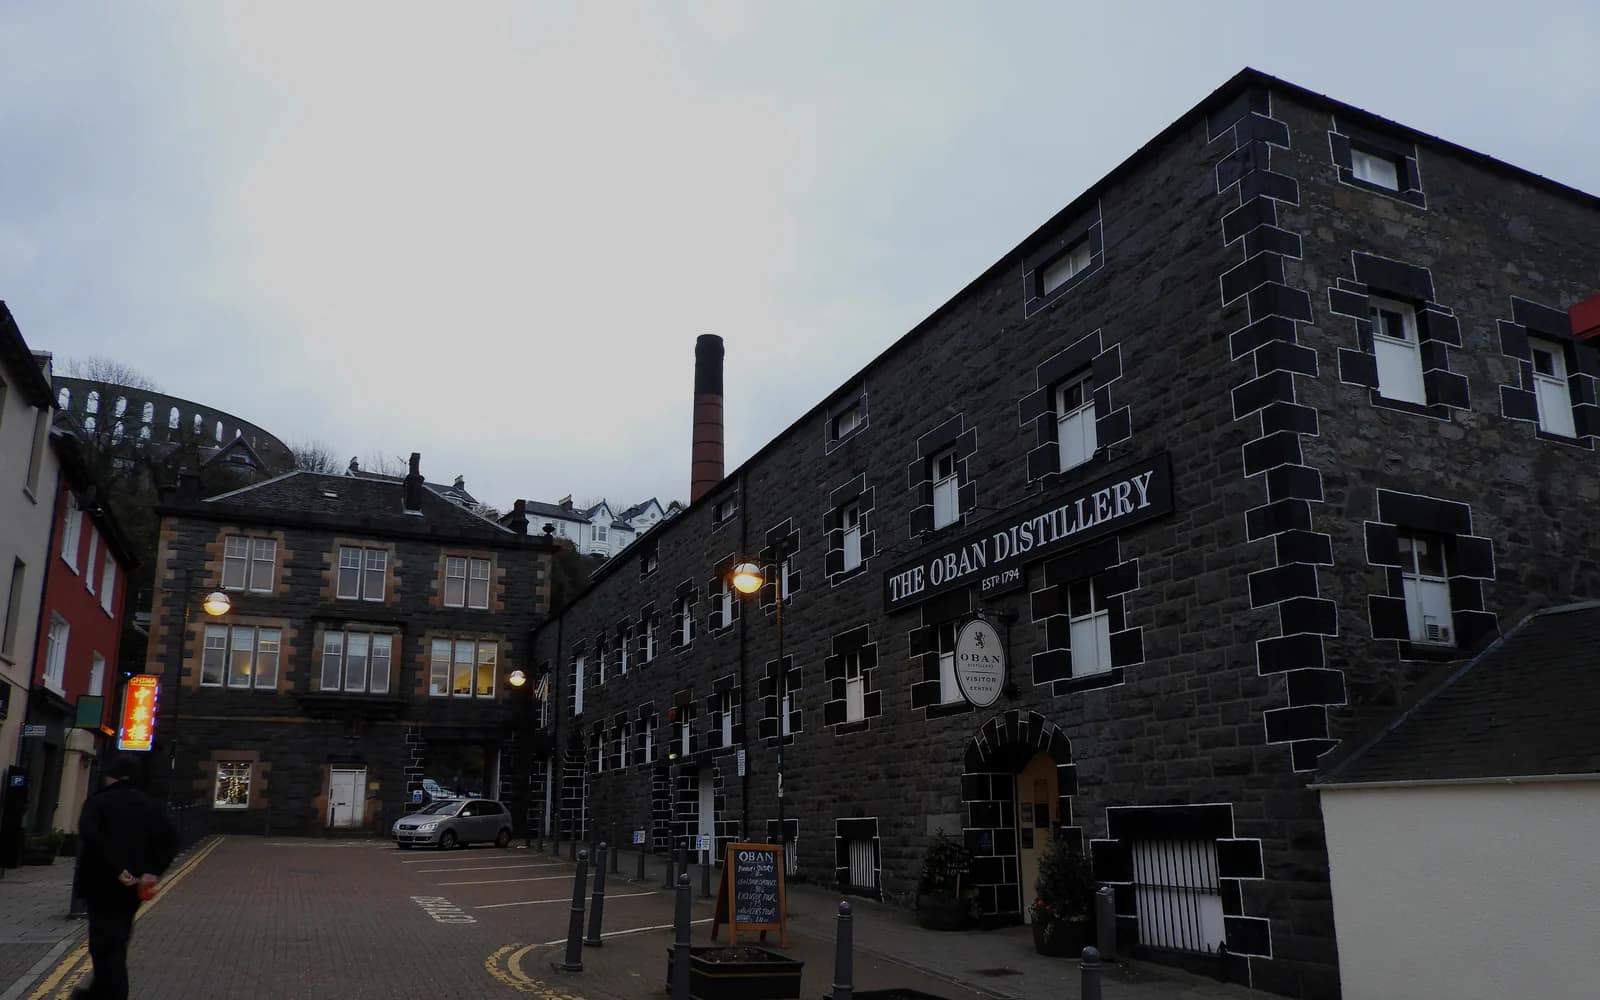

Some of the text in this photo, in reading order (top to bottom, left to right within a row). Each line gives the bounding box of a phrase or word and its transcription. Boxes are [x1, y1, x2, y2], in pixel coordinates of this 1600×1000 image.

[889, 470, 1154, 602] THE OBAN DISTILLERY
[1001, 567, 1020, 584] 1794
[960, 653, 1000, 663] OBAN
[738, 851, 774, 862] OBAN
